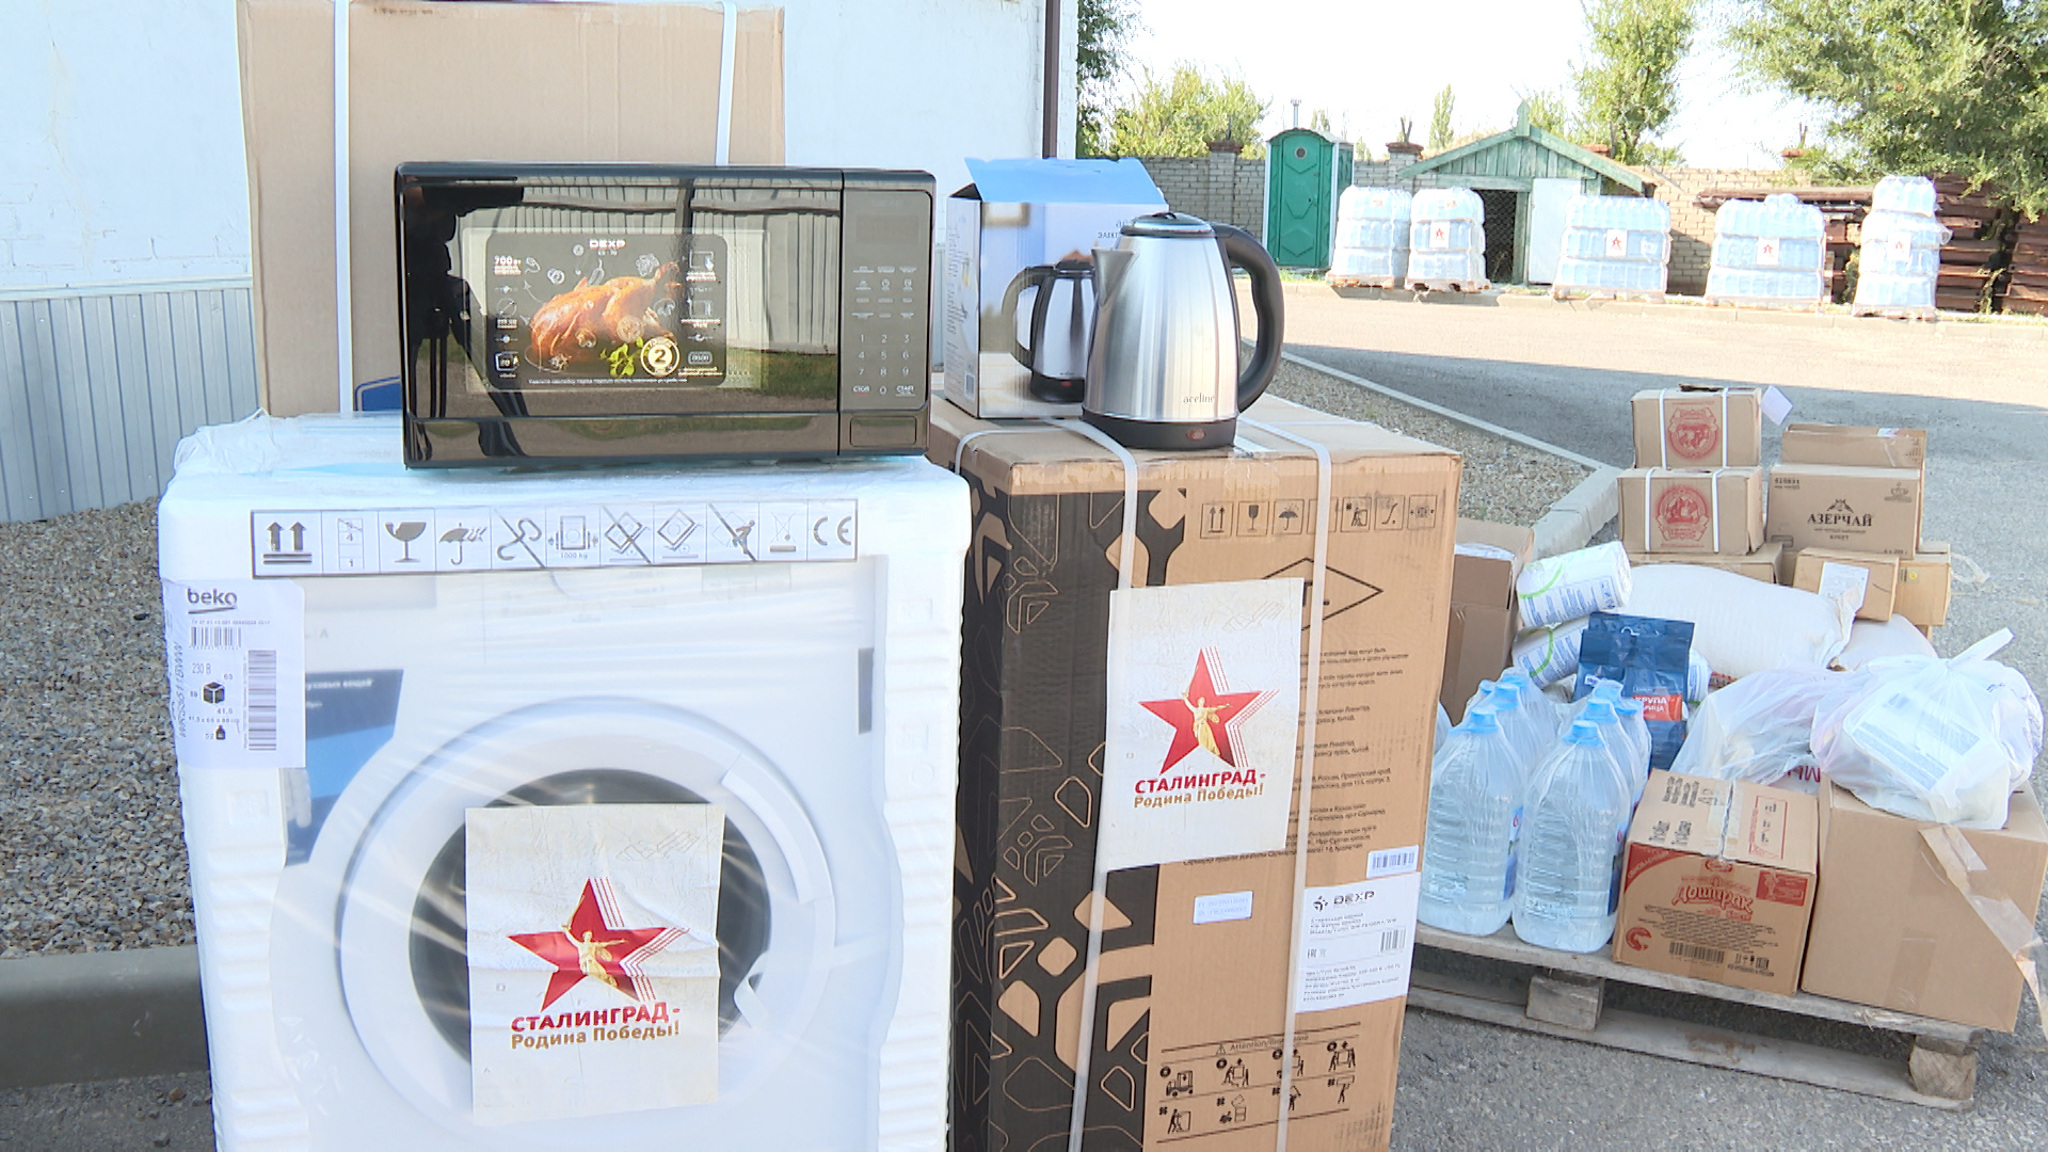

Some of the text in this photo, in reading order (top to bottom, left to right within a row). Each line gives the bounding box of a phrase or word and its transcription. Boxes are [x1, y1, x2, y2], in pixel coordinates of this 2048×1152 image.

[589, 239, 626, 249] DEXP
[881, 334, 887, 343] 2
[904, 334, 910, 343] 3
[654, 349, 666, 363] 2
[859, 351, 909, 360] 4 5 6
[859, 366, 909, 377] 7 8 9
[879, 386, 887, 395] 0
[1807, 513, 1872, 527] АЗЕРЧАЙ
[187, 588, 237, 605] beko
[1135, 769, 1266, 794] СТАЛИНГРАД-
[1134, 783, 1264, 808] Родина Победы!
[1334, 890, 1375, 905] DEXP
[1672, 885, 1754, 915] Доширак
[511, 1002, 681, 1032] СТАЛИНГРАД-
[511, 1020, 680, 1050] Родина Победы!
